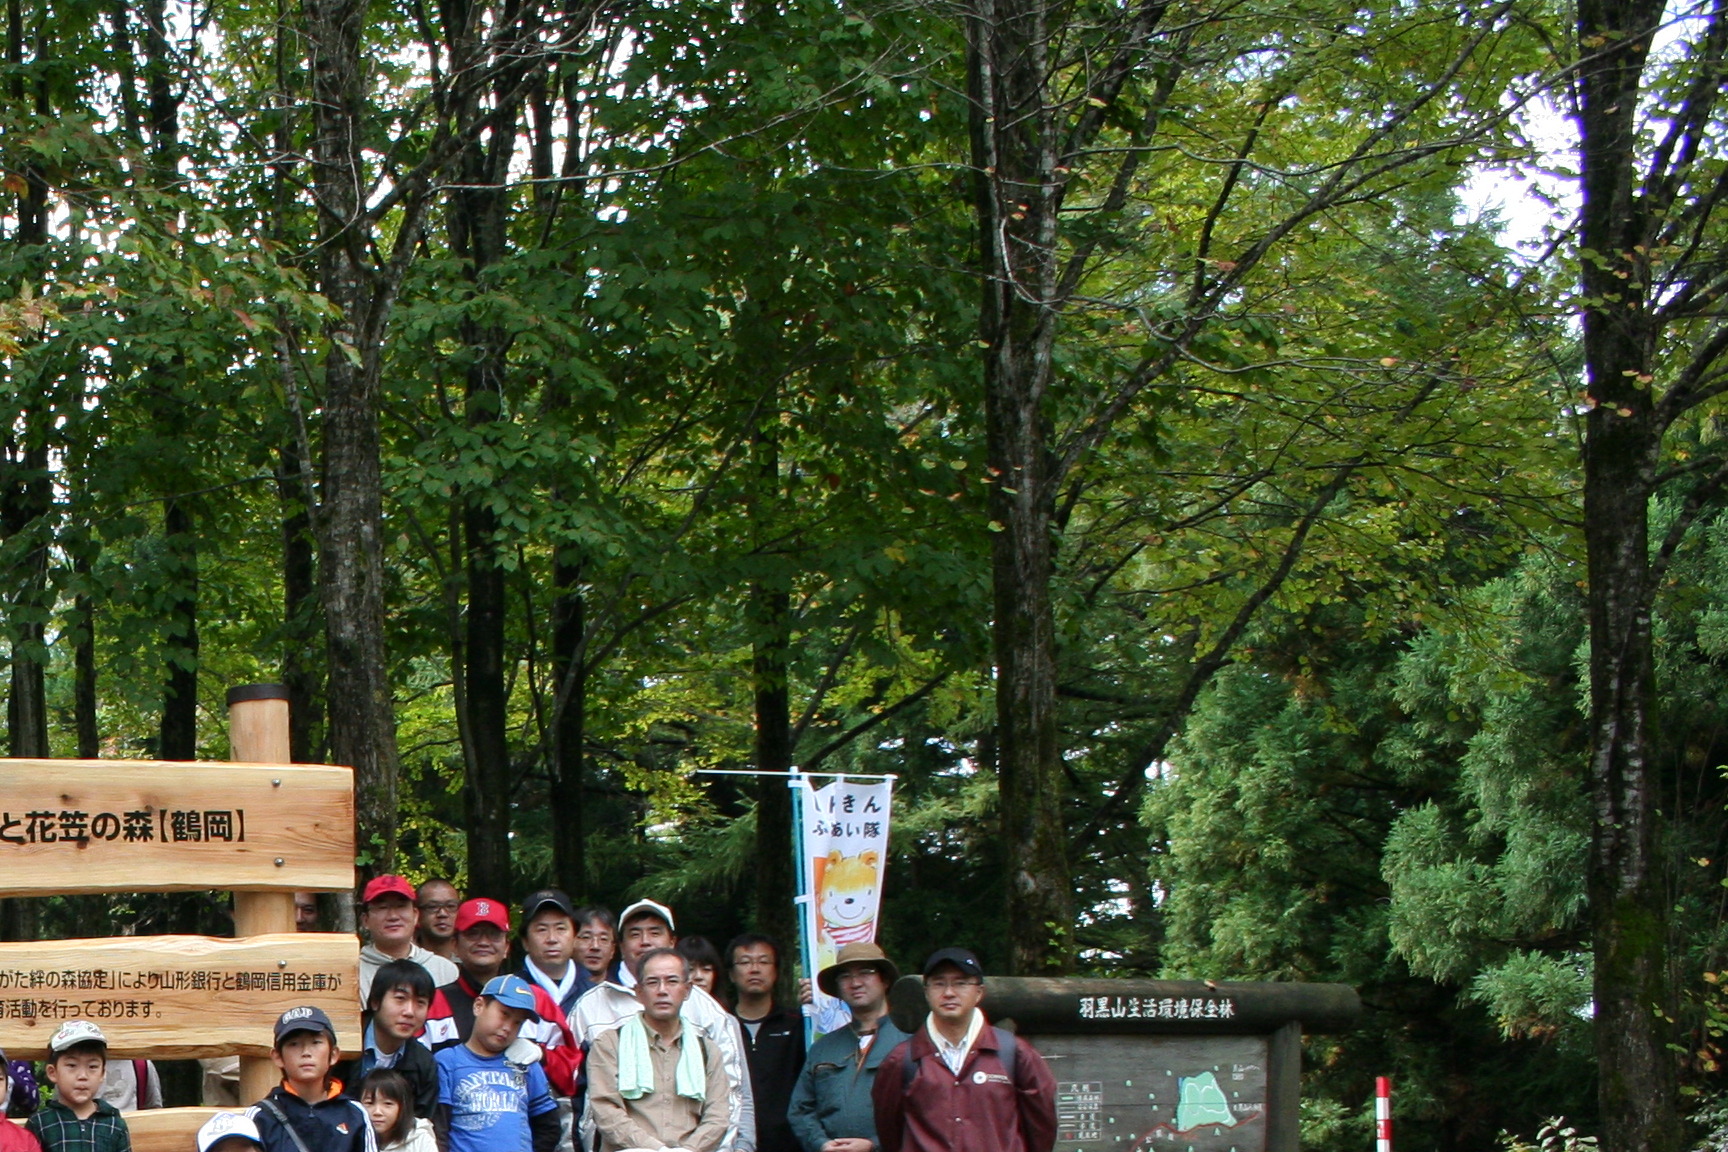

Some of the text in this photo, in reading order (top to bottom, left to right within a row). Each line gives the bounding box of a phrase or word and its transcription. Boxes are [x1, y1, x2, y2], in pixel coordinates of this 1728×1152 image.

[282, 1006, 314, 1025] GAP
[1079, 997, 1235, 1020] 羽黒山生活環境保全林
